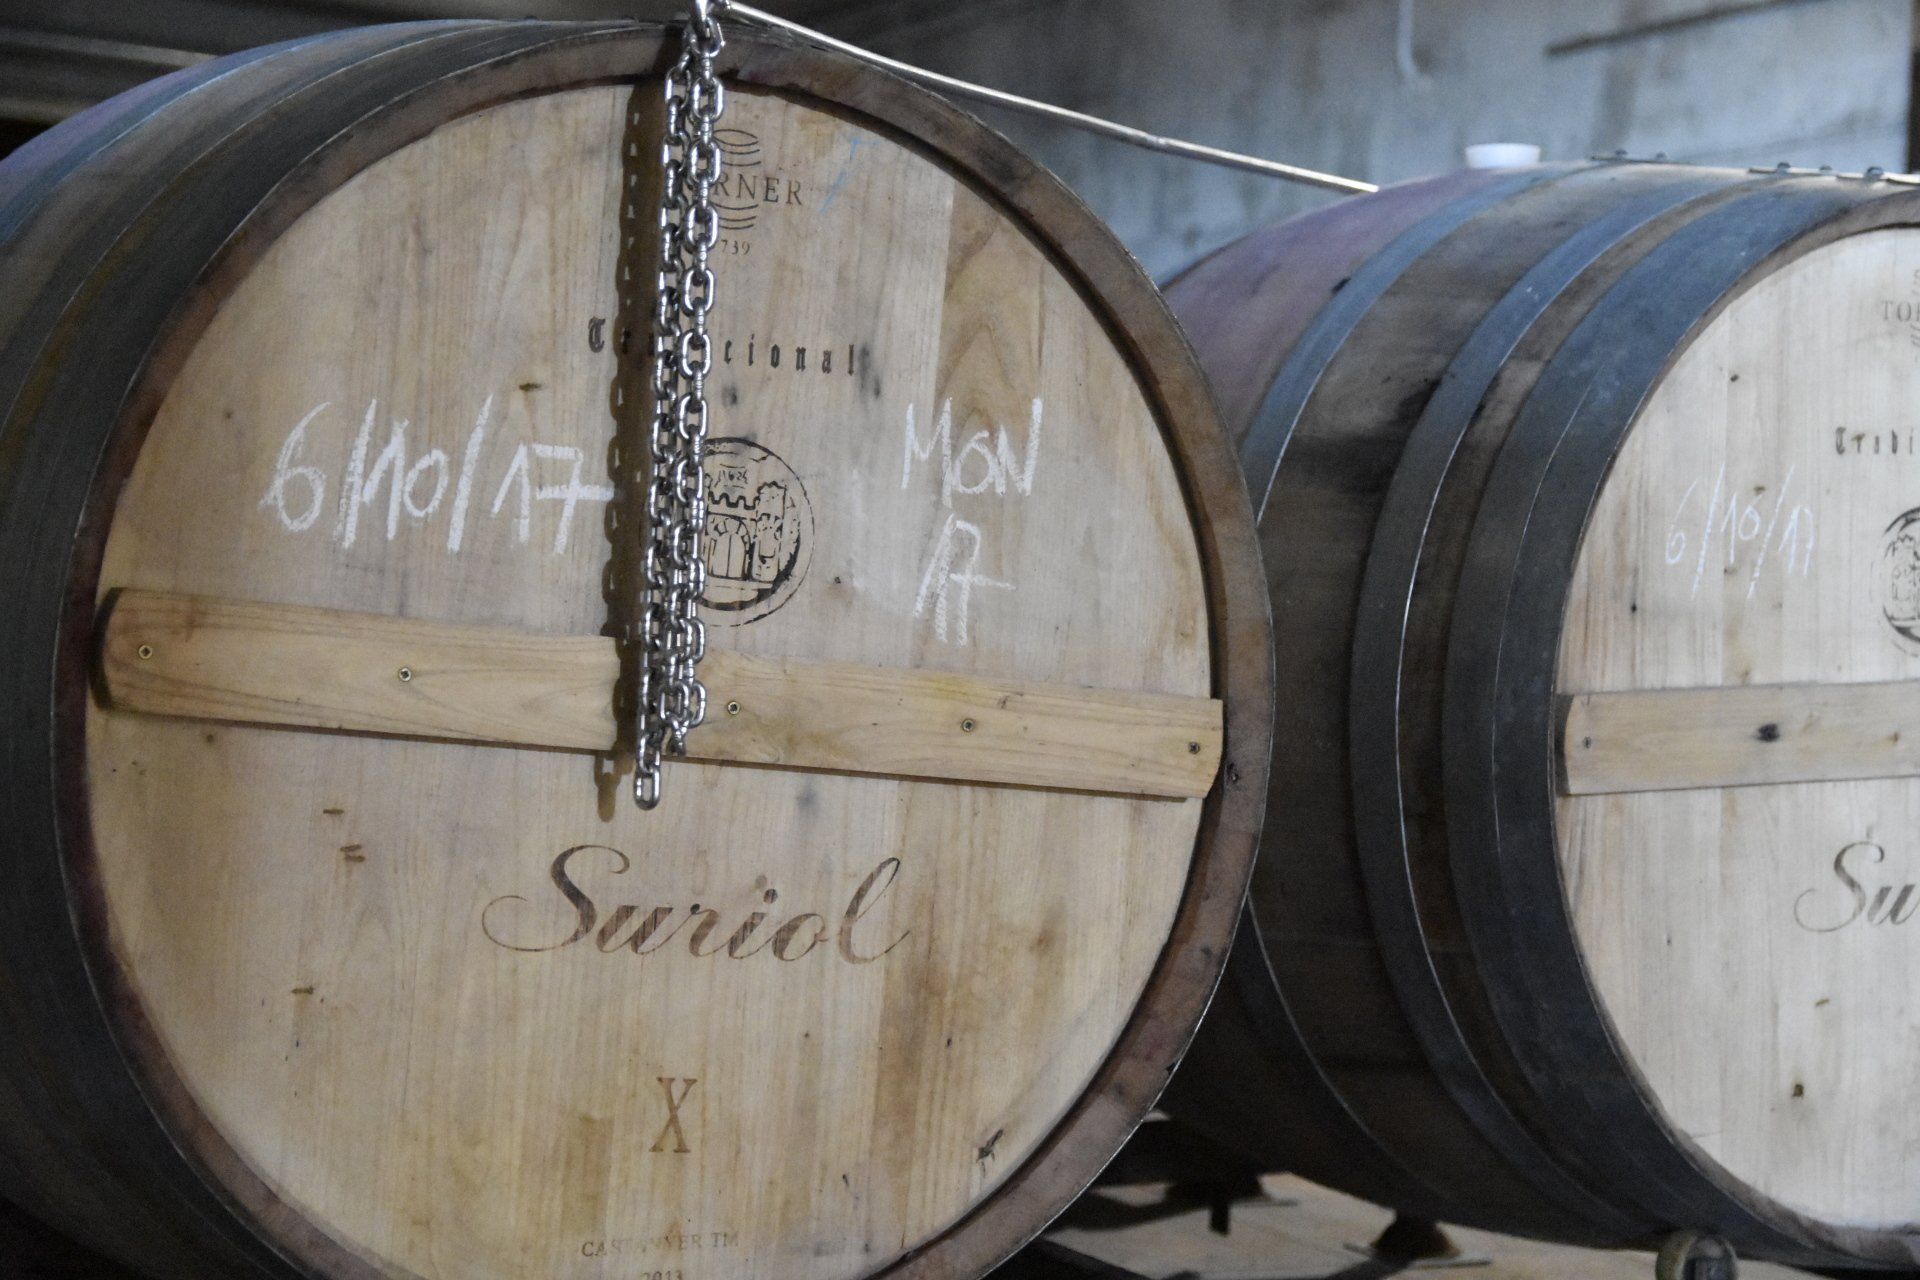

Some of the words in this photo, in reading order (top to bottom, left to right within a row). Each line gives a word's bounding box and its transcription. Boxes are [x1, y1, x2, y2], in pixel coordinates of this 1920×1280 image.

[712, 171, 803, 206] RNER
[718, 239, 751, 255] 739
[257, 394, 615, 555] 6/10/17
[481, 843, 910, 965] Suriol
[648, 1076, 698, 1154] X
